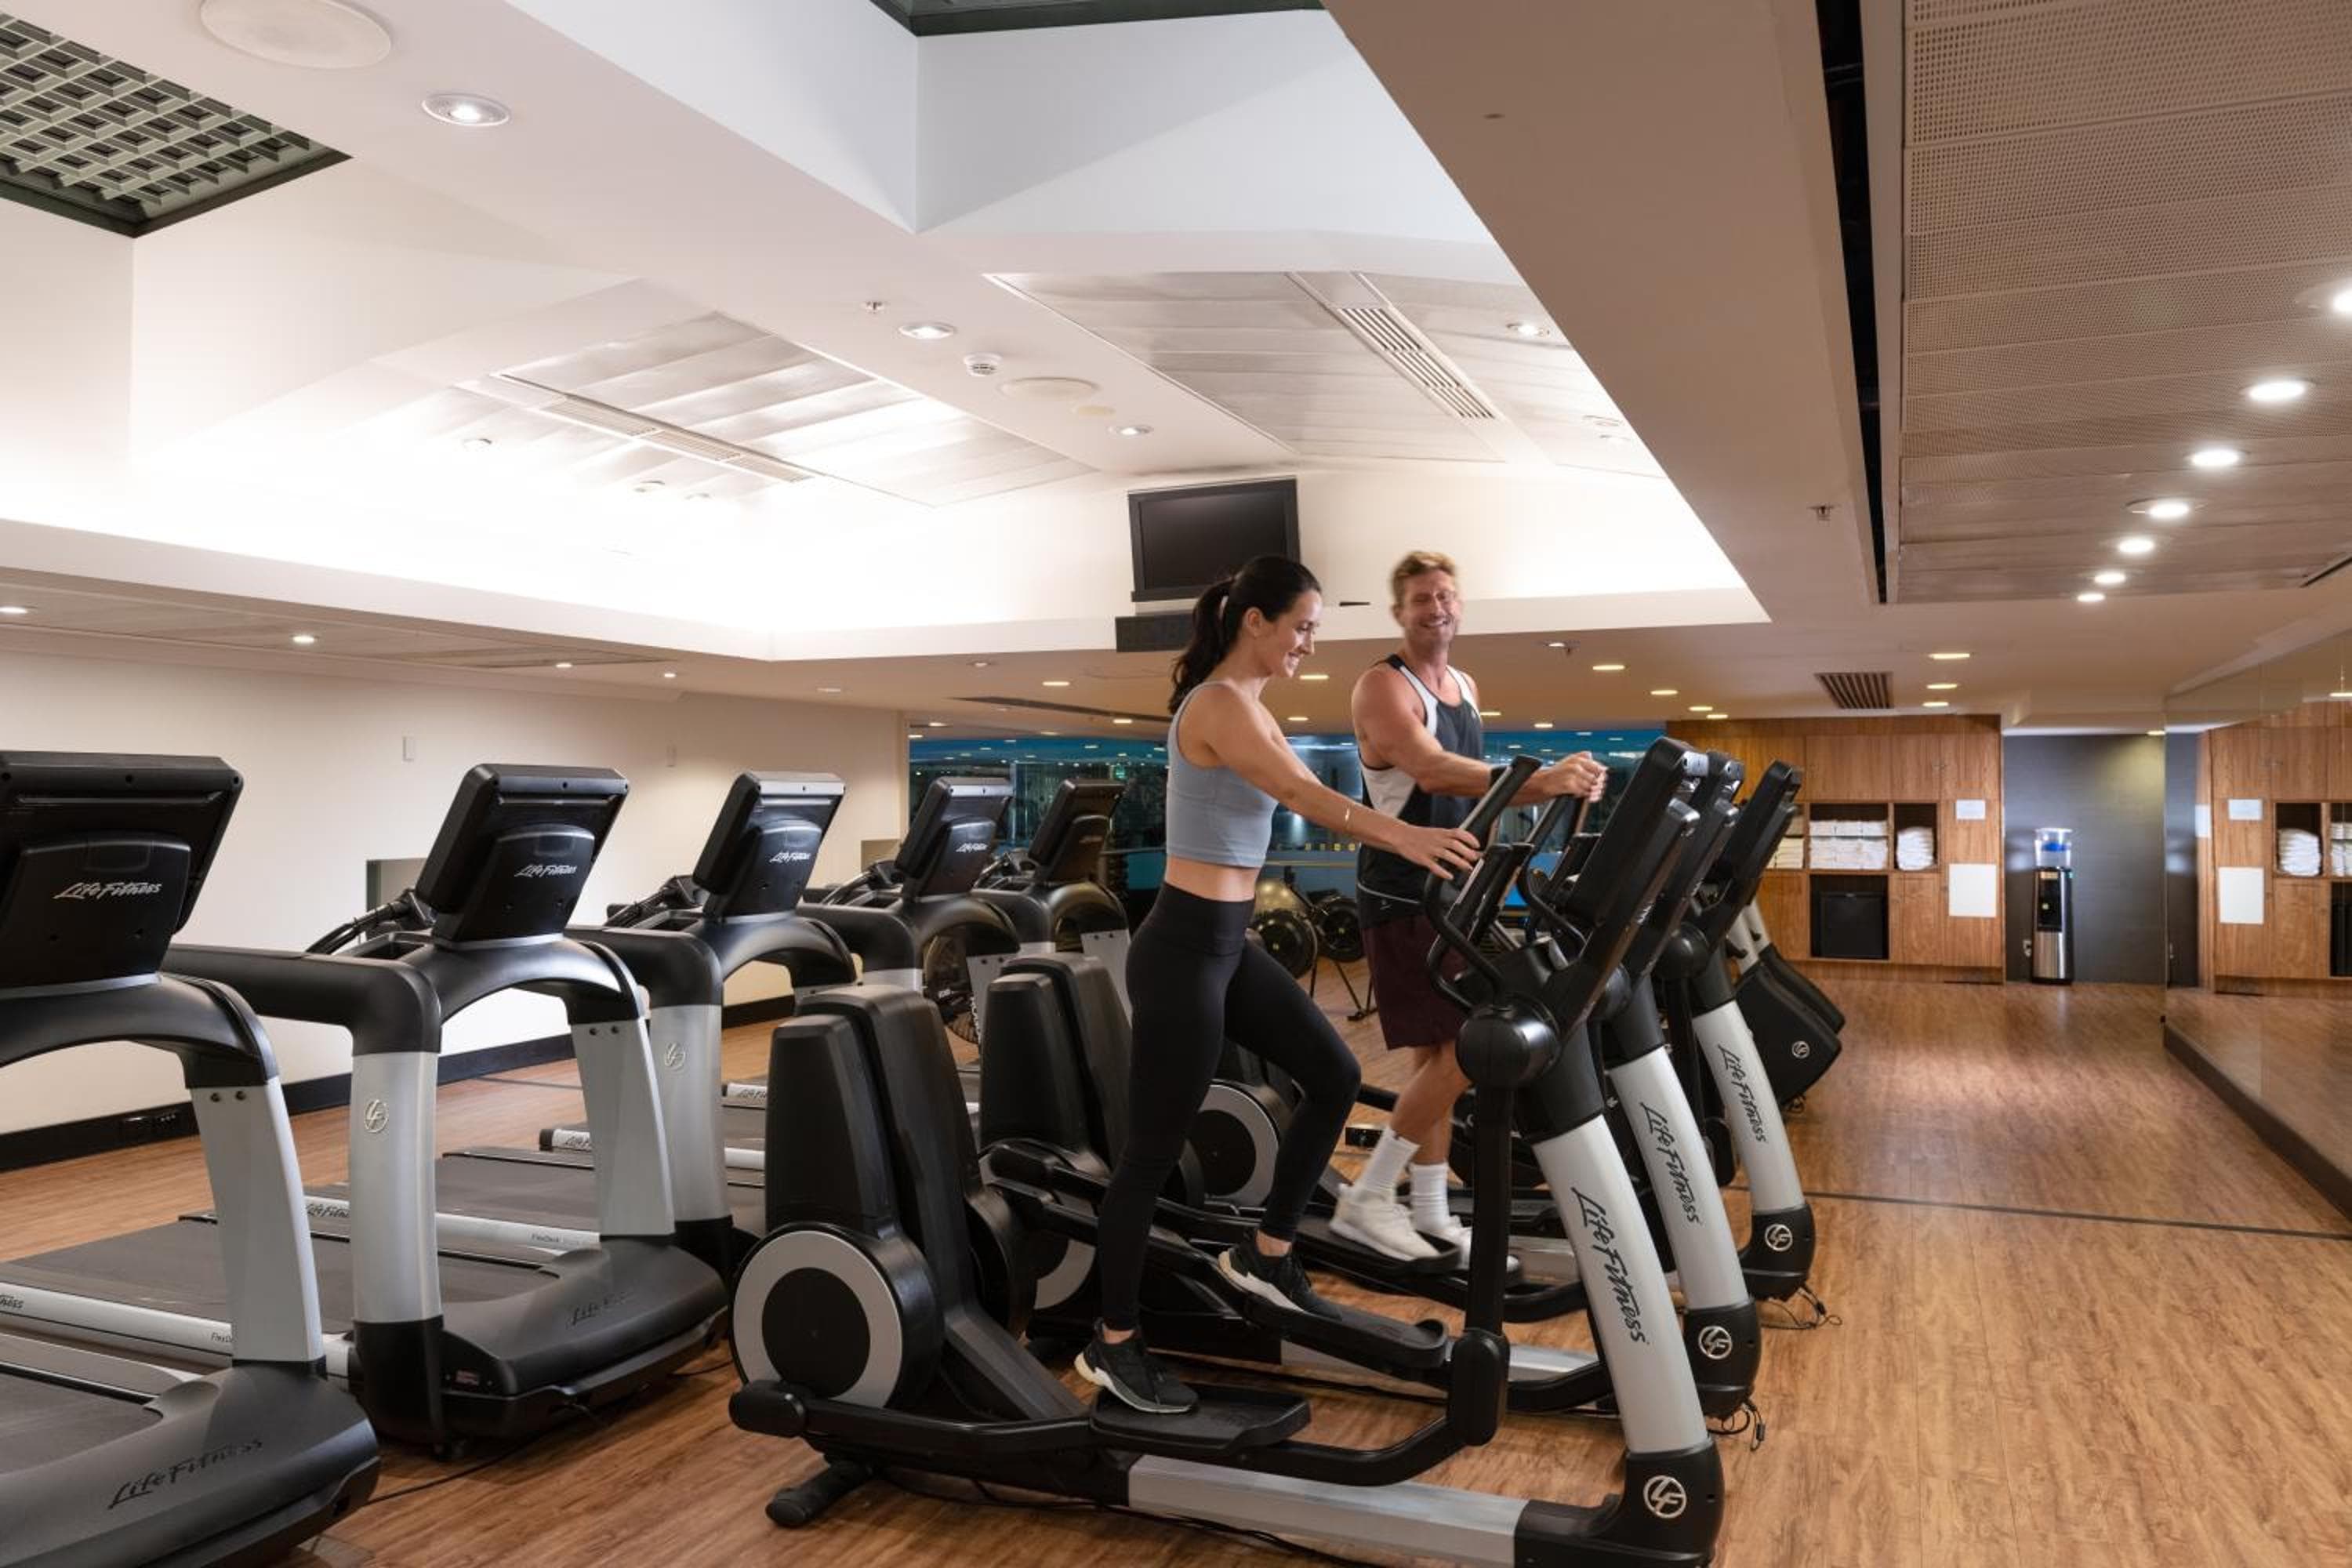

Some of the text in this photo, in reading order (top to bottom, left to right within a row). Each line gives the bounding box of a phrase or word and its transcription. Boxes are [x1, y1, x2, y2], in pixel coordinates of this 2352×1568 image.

[53, 882, 100, 899] Life
[1718, 1044, 1766, 1142] Life Fitness
[1640, 1102, 1700, 1223] Life Fitness
[1571, 1187, 1646, 1344] Life Fitness
[108, 1439, 263, 1510] Life Fitness
